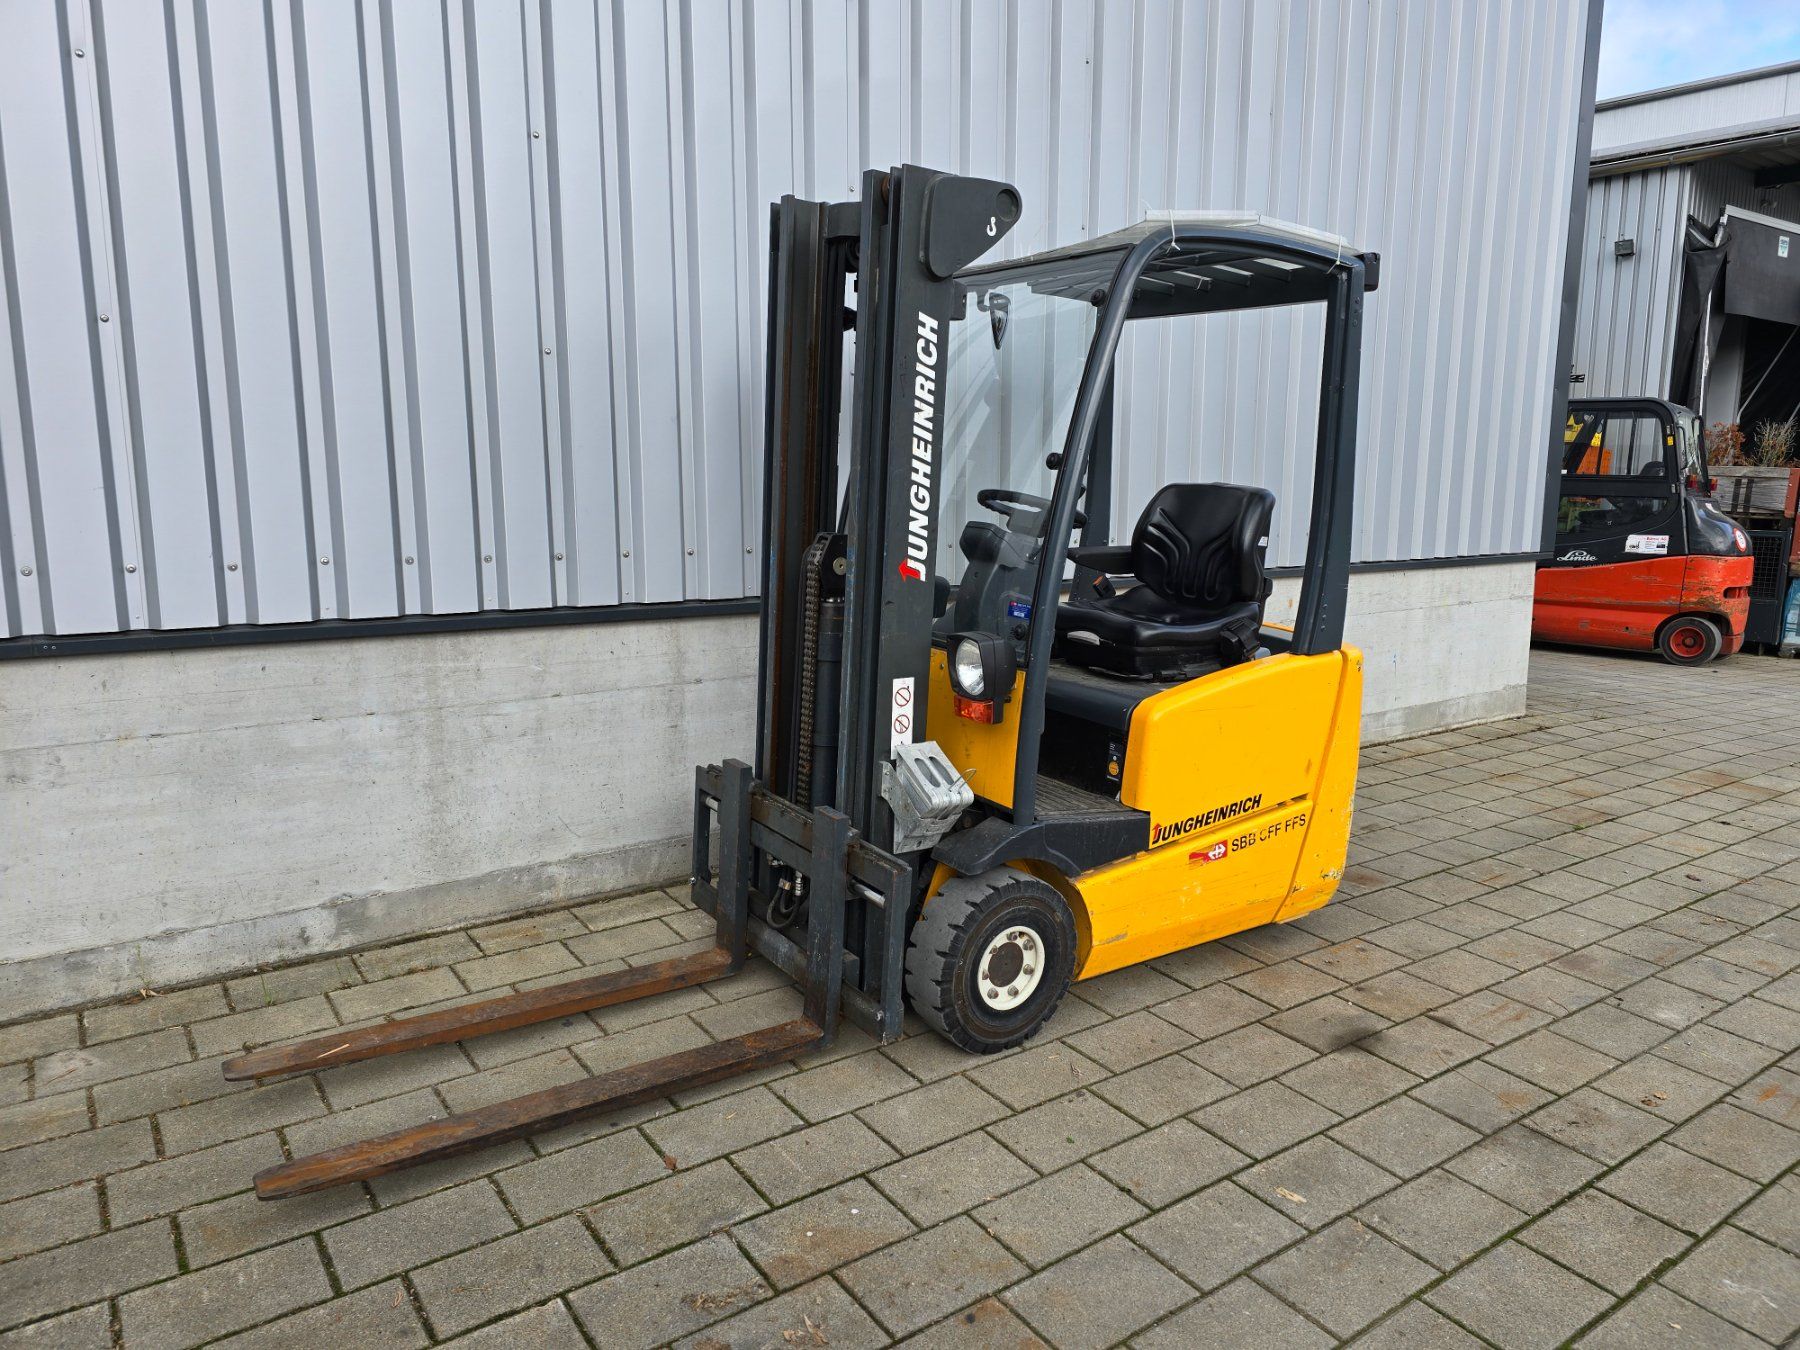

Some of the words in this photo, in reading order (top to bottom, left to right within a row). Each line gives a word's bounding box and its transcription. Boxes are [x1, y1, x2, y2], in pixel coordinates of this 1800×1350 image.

[898, 311, 939, 582] JUNGHEINRICH
[1556, 550, 1599, 562] Linde
[1152, 793, 1262, 845] JUNGHEINRICH
[1231, 832, 1256, 852] SBB
[1285, 813, 1306, 832] FFS
